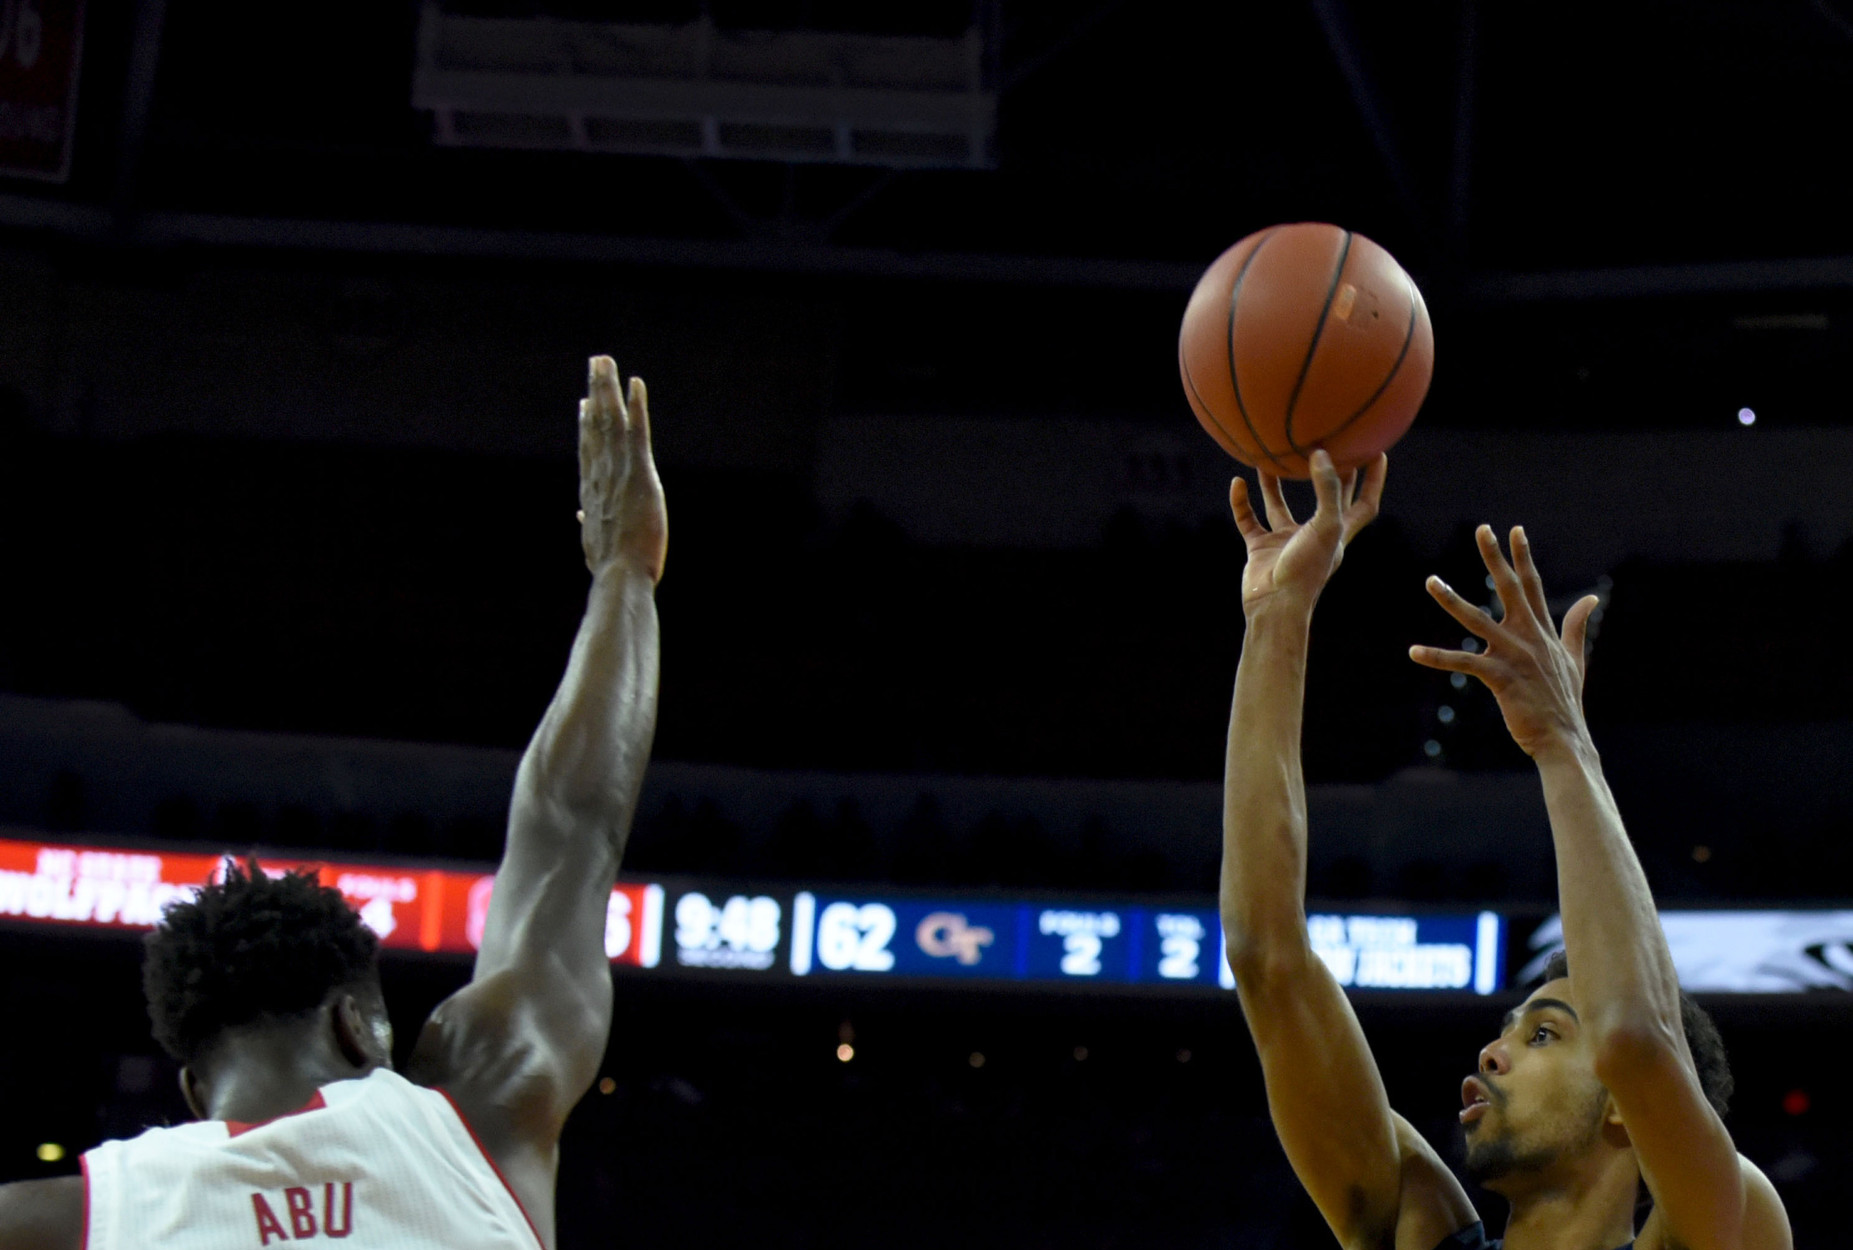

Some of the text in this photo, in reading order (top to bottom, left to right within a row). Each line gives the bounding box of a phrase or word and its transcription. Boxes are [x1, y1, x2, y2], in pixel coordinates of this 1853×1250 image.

[676, 893, 780, 953] 9:48
[818, 902, 896, 971] 62
[1061, 933, 1102, 975] 2
[1158, 935, 1199, 978] 2
[251, 1182, 354, 1246] ABU
